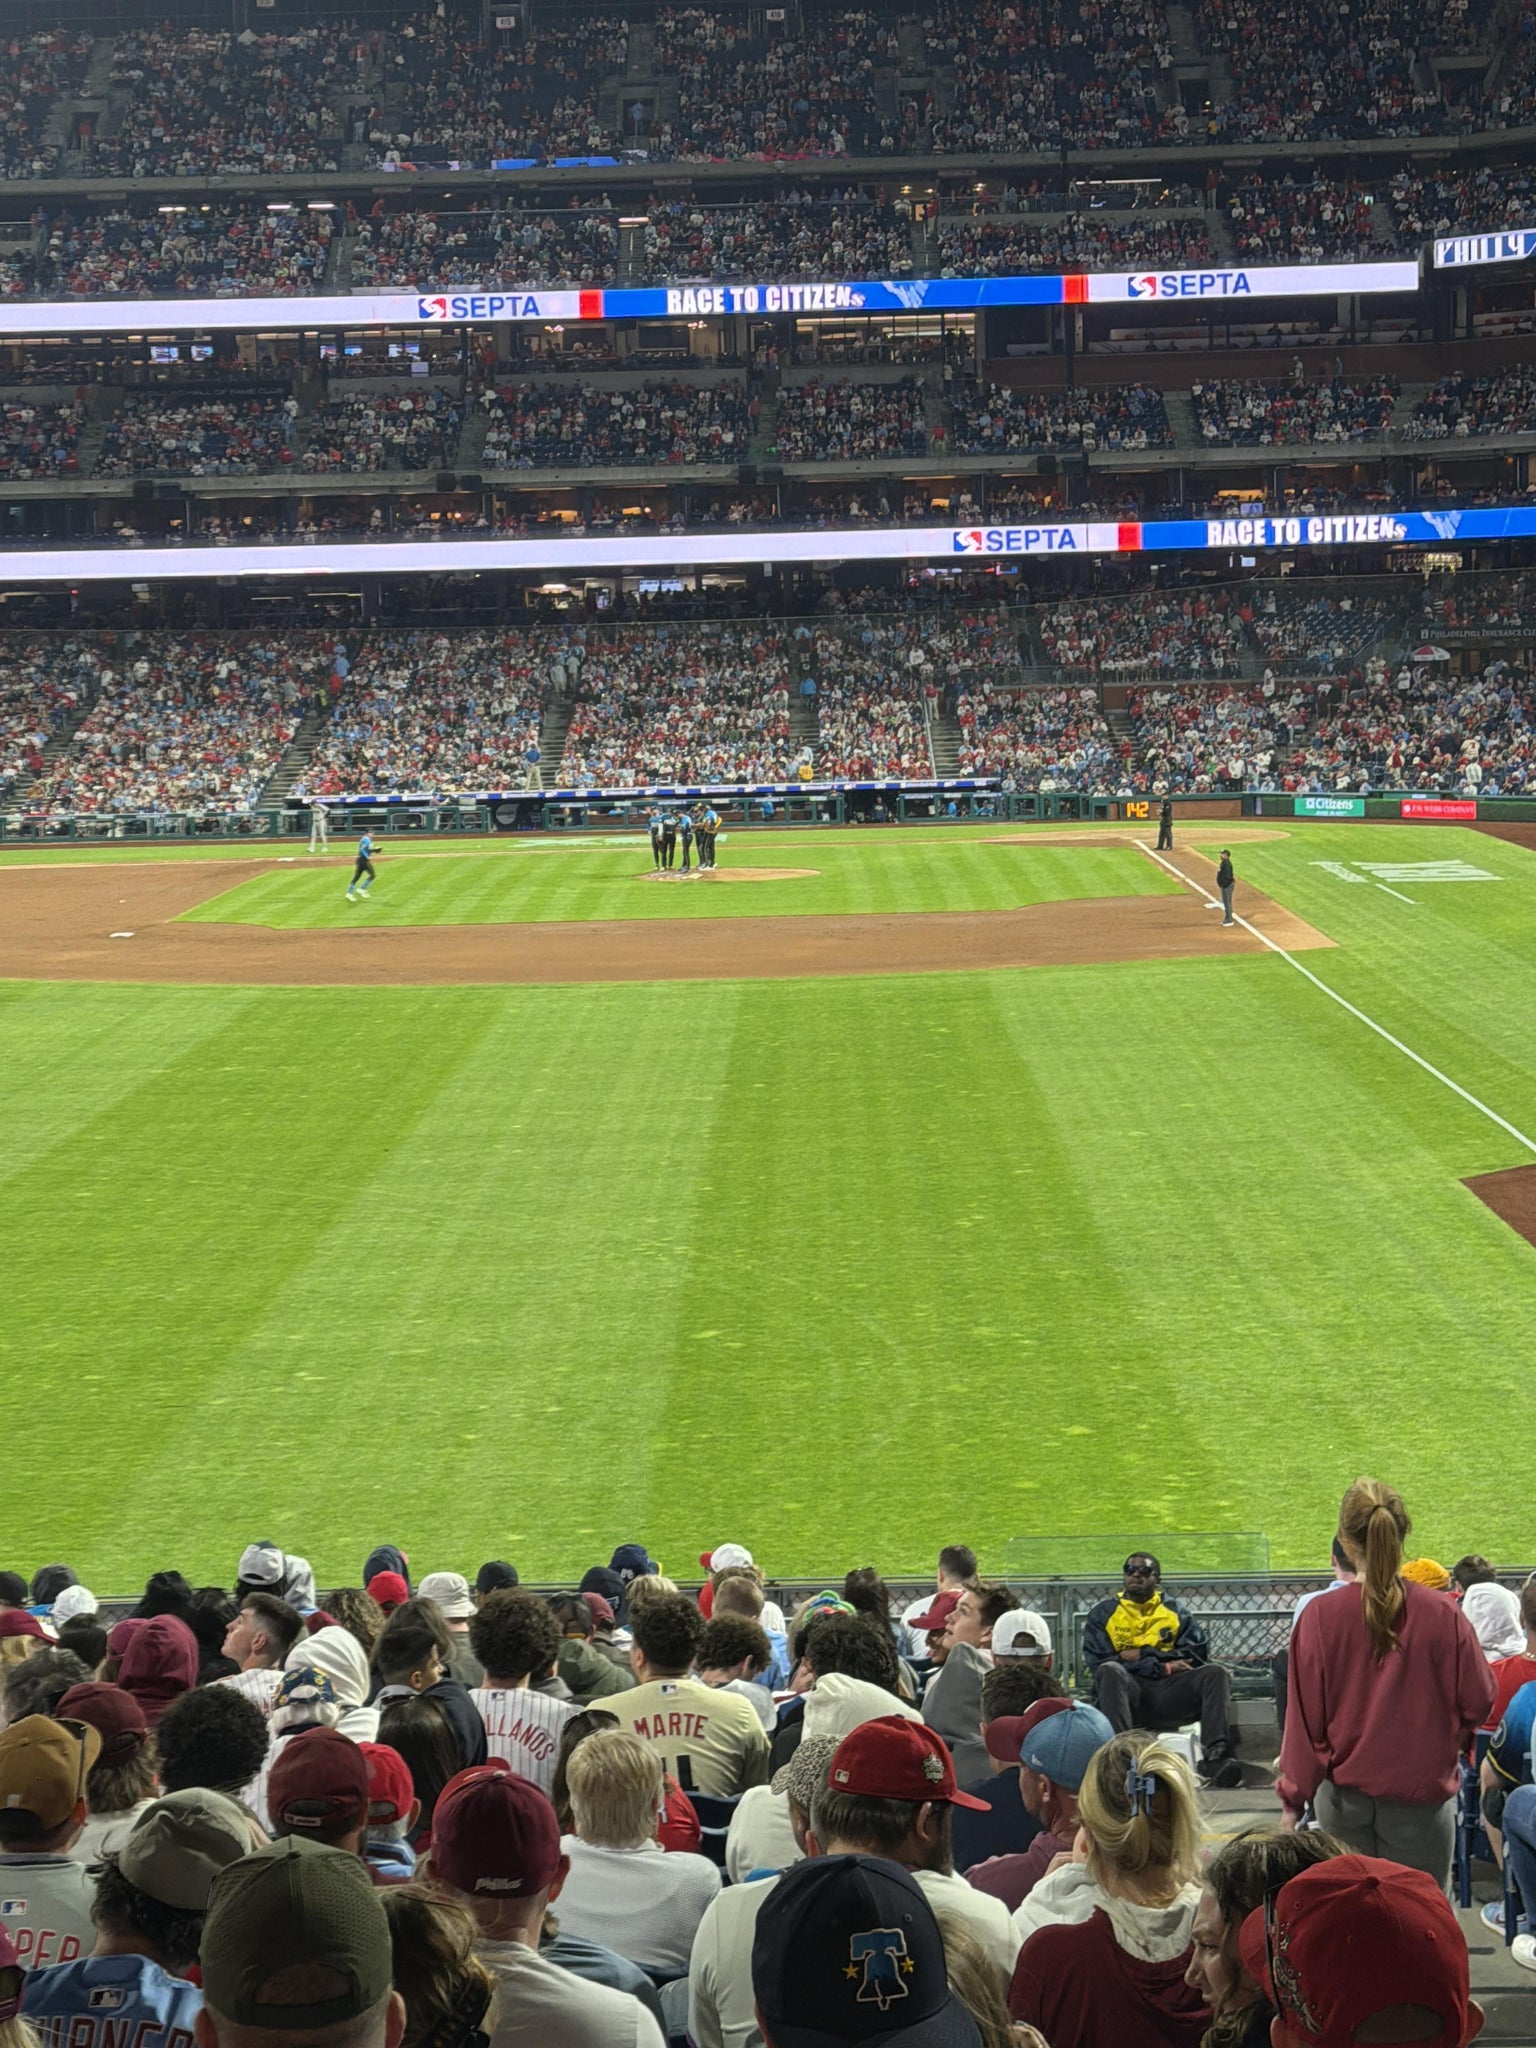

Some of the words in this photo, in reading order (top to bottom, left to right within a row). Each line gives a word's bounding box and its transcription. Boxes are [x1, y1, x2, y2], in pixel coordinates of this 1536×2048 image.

[1160, 273, 1251, 297] SEPTA
[451, 296, 541, 318] SEPTA
[666, 289, 725, 314] RACE
[729, 286, 759, 311] TO
[986, 528, 1077, 552] SEPTA
[1207, 520, 1266, 545] RACE
[1272, 518, 1300, 543] TO
[1316, 797, 1354, 809] Citizens
[486, 1713, 557, 1762] LLANOS
[633, 1712, 709, 1741] MARTE
